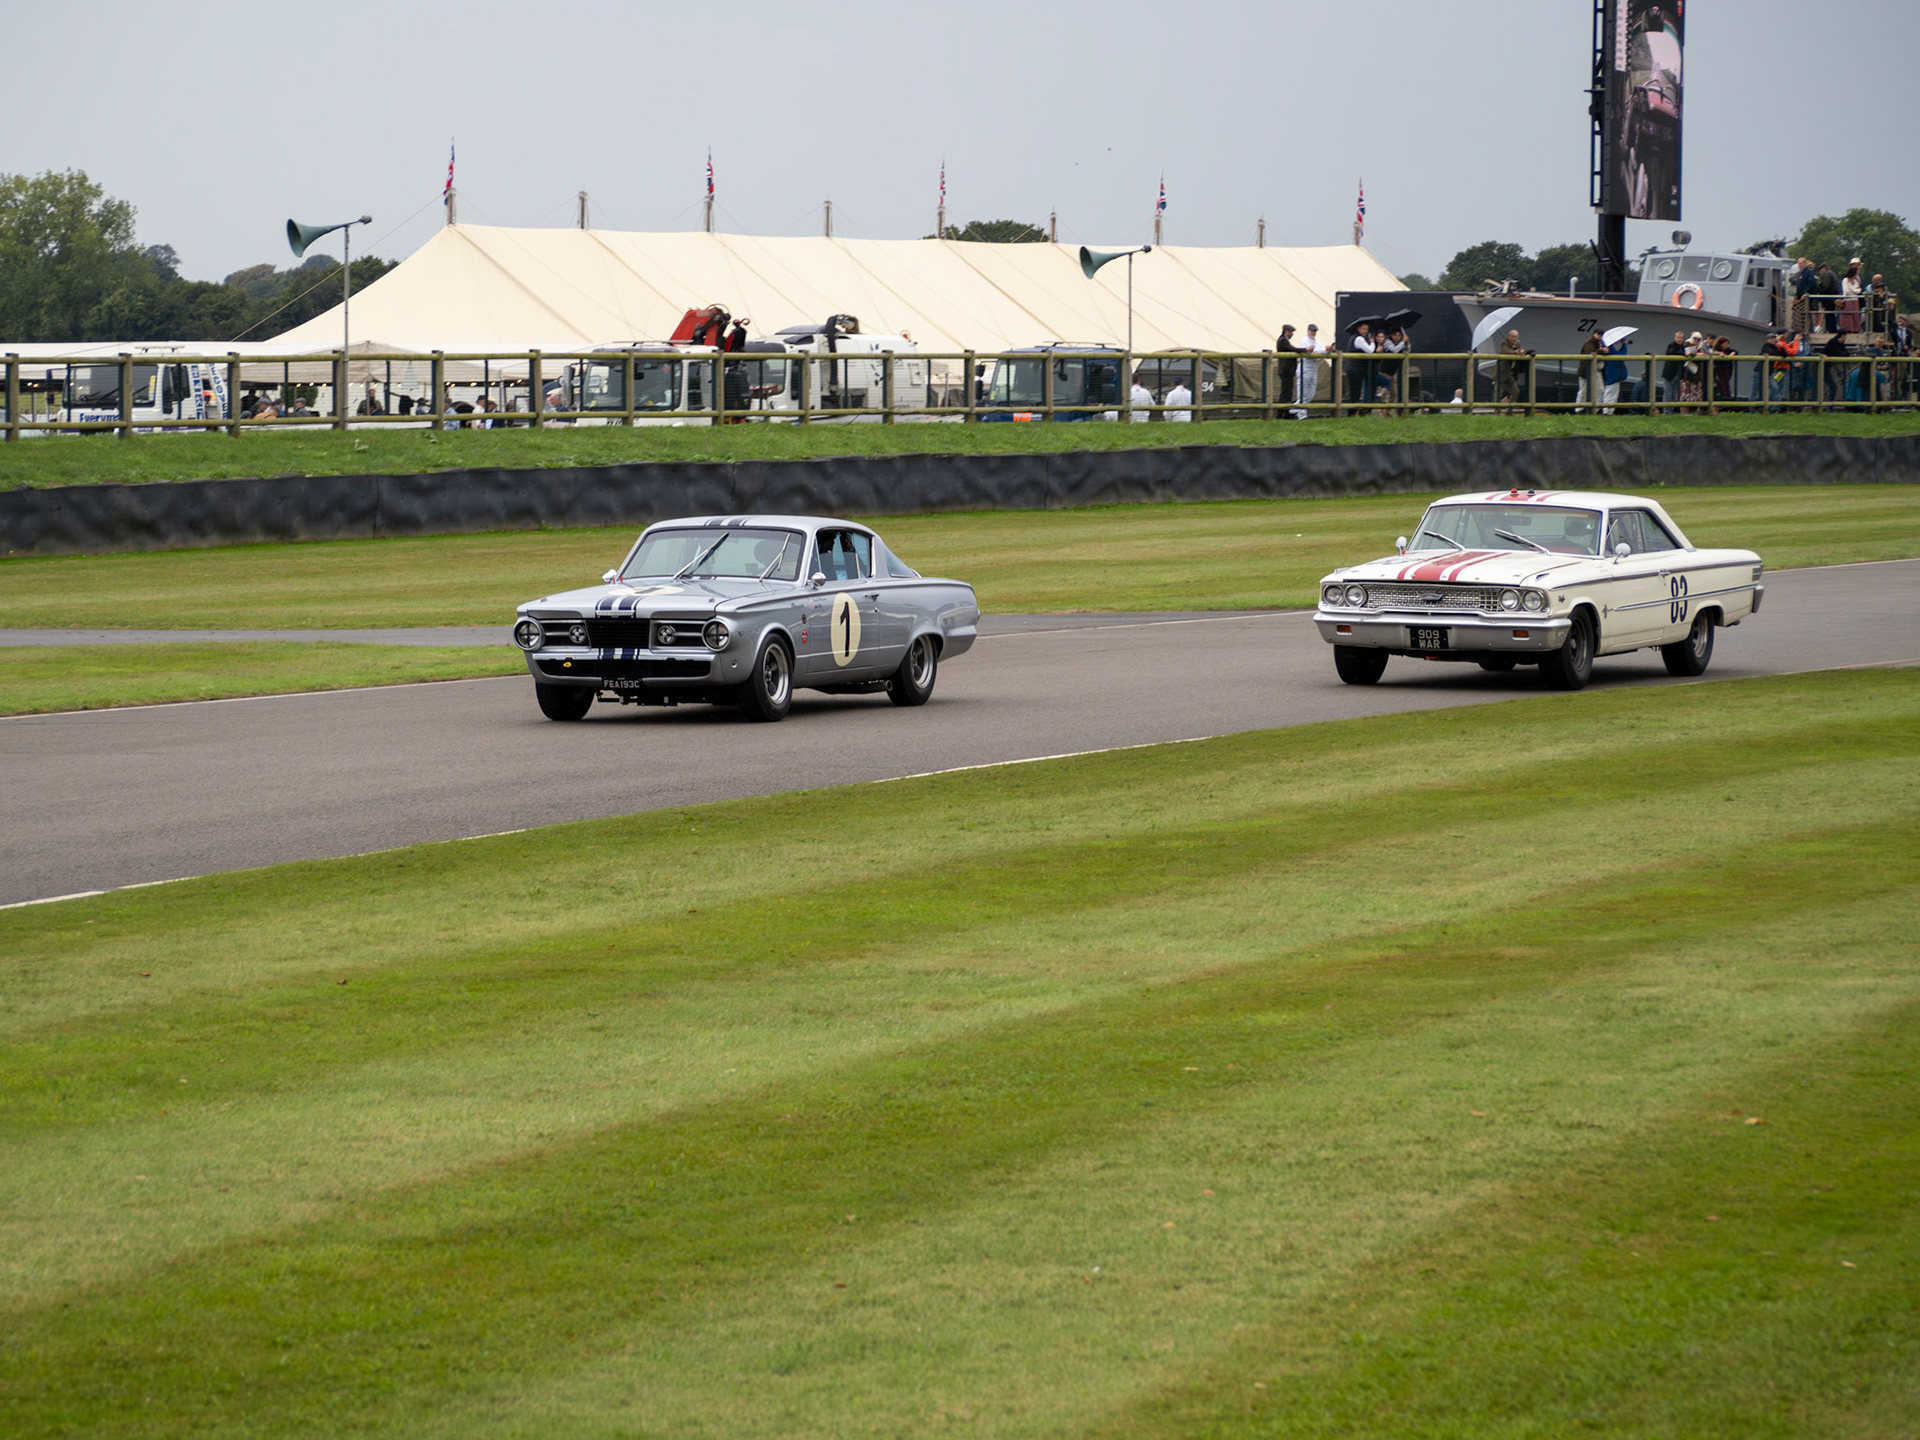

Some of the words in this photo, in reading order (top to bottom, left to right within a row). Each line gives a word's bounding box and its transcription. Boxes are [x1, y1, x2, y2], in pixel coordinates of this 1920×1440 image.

[1577, 318, 1598, 332] 27
[1670, 574, 1689, 624] 83
[840, 601, 851, 657] 1
[1418, 629, 1440, 639] 909
[1418, 639, 1441, 649] WAR
[603, 679, 641, 689] FEA193C
